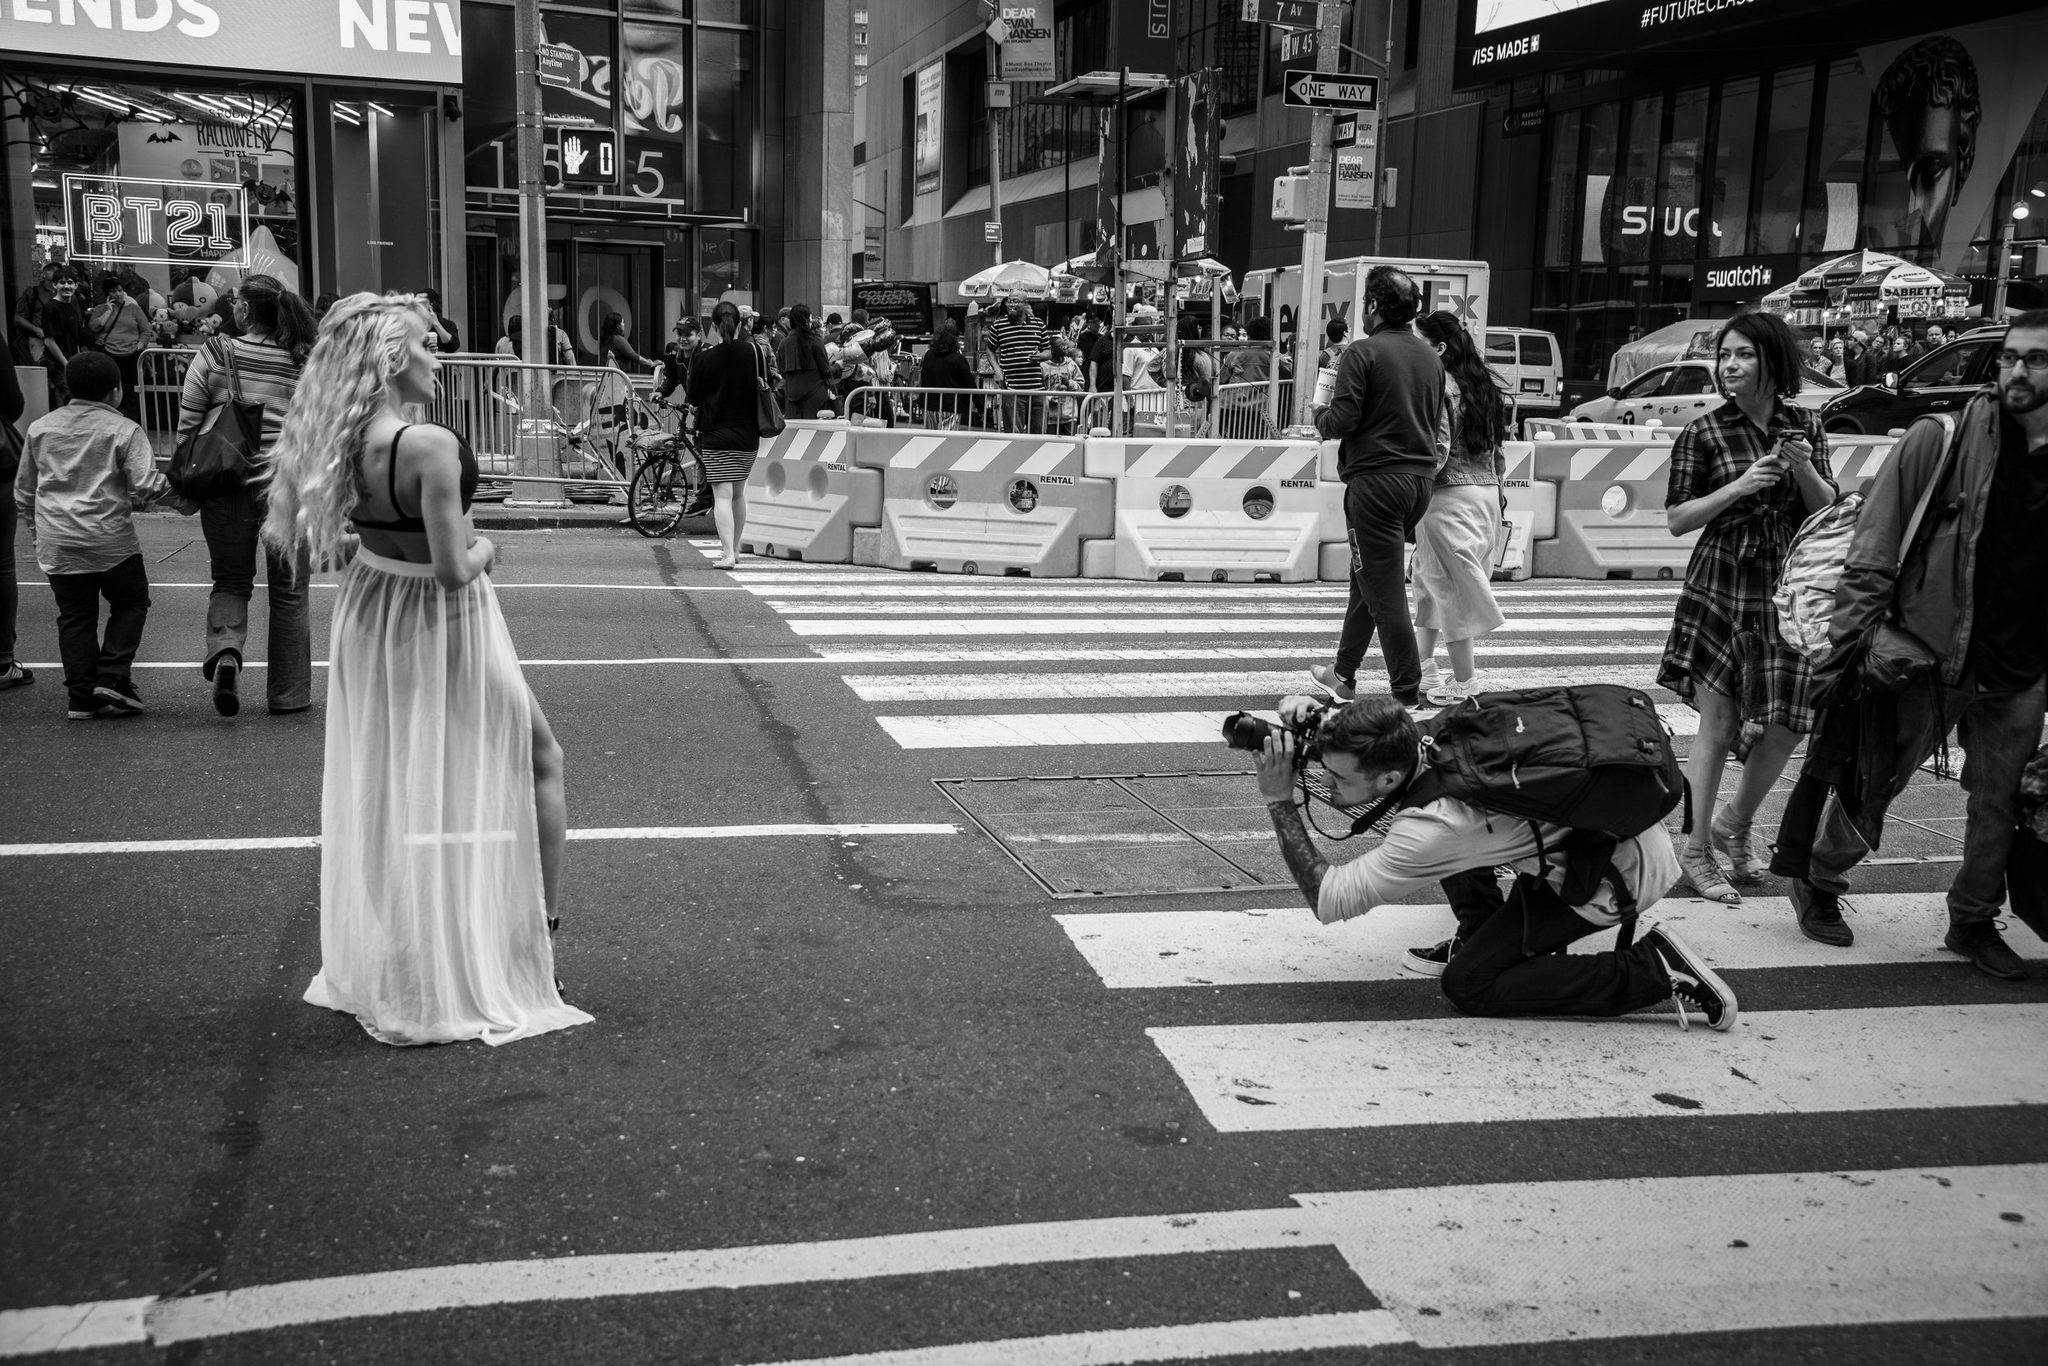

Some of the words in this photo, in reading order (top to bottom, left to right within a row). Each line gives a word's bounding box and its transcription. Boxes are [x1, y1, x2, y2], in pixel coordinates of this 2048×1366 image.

[1002, 7, 1036, 19] DEAR
[1276, 2, 1284, 21] 7
[1003, 19, 1034, 29] EVAN
[1291, 37, 1299, 55] W
[1302, 34, 1313, 53] 45
[1496, 37, 1530, 60] MADE
[542, 48, 549, 56] NO
[550, 50, 574, 61] STANDING
[542, 58, 563, 69] Anytime
[1300, 82, 1326, 97] ONE
[1338, 85, 1366, 100] WAY
[1340, 156, 1363, 164] DEAR
[1339, 163, 1360, 171] EVAN
[1338, 171, 1373, 179] HANSEN
[83, 194, 232, 248] BT21
[1706, 264, 1762, 288] swatch
[858, 289, 913, 299] GOLDEN
[1884, 286, 1940, 297] SABRETT
[865, 296, 908, 305] TOUCH
[827, 463, 846, 471] RENTAL
[1040, 475, 1073, 485] RENTAL
[1281, 480, 1314, 488] RENTAL
